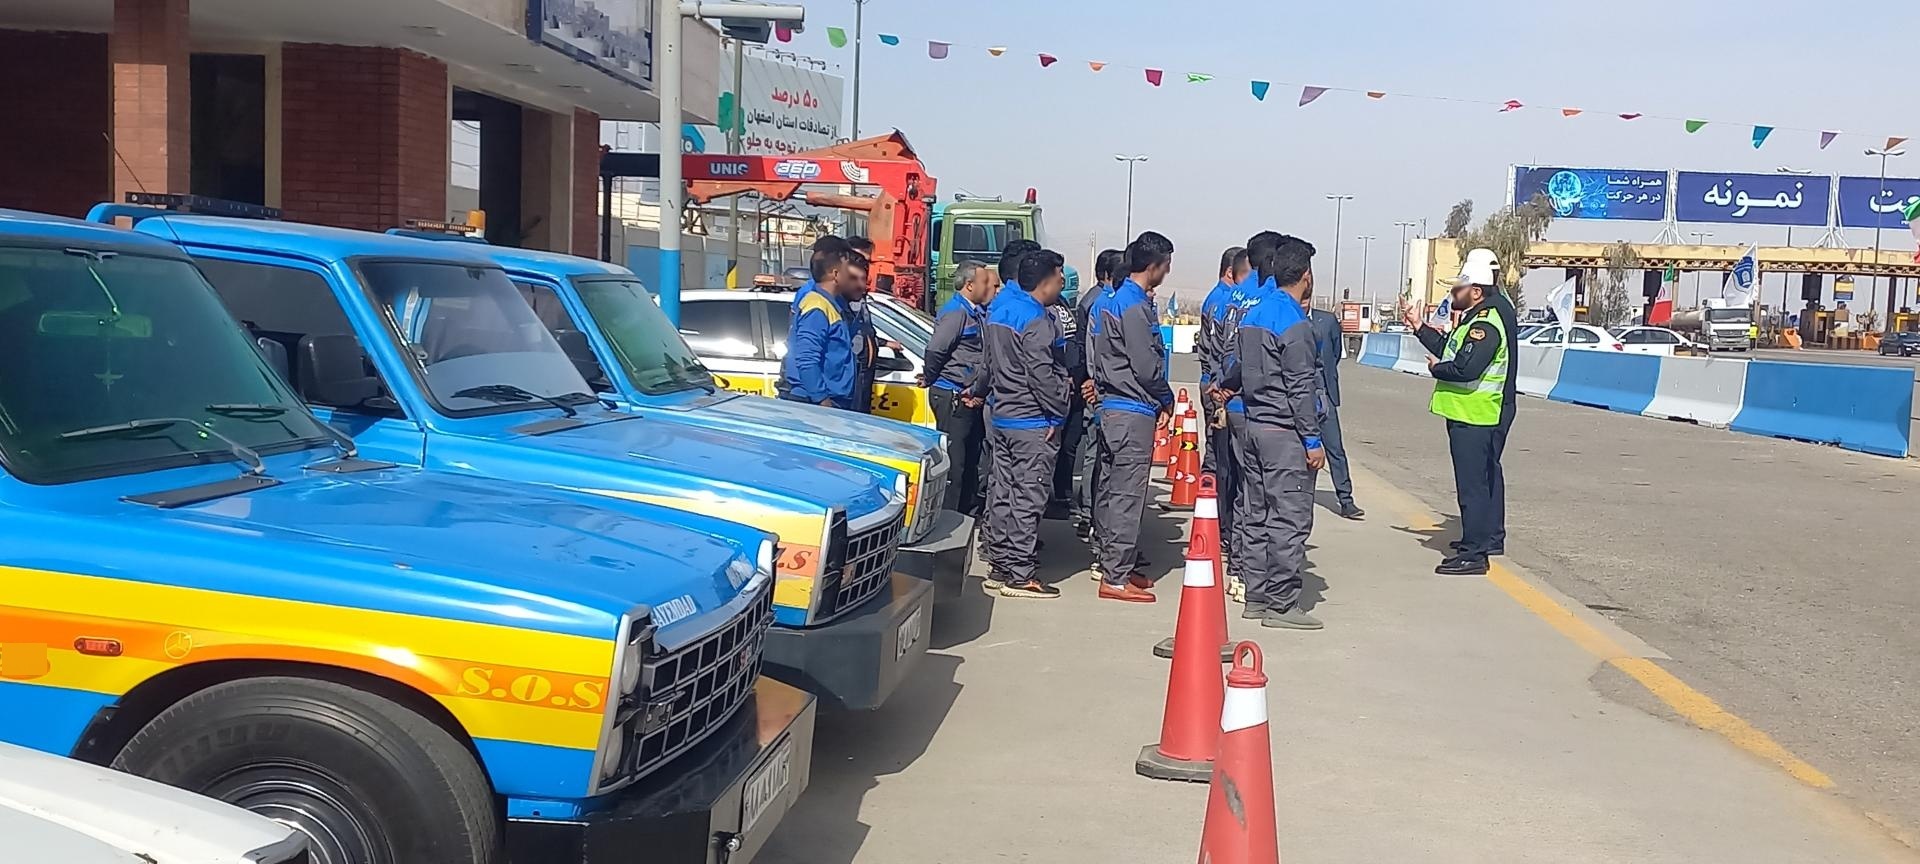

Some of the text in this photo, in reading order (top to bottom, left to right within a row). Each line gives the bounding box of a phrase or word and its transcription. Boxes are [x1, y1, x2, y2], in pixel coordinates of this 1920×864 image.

[771, 87, 818, 109] ۵۰ درصد
[746, 108, 837, 140] از تصادفات استان اصفهان
[746, 131, 762, 151] جلو
[763, 137, 773, 154] به
[775, 139, 796, 156] توجه
[1606, 174, 1663, 188] همراه شما
[1605, 190, 1662, 204] در هر حرکت
[1702, 178, 1805, 217] نمونه
[456, 666, 605, 710] S.O.S
